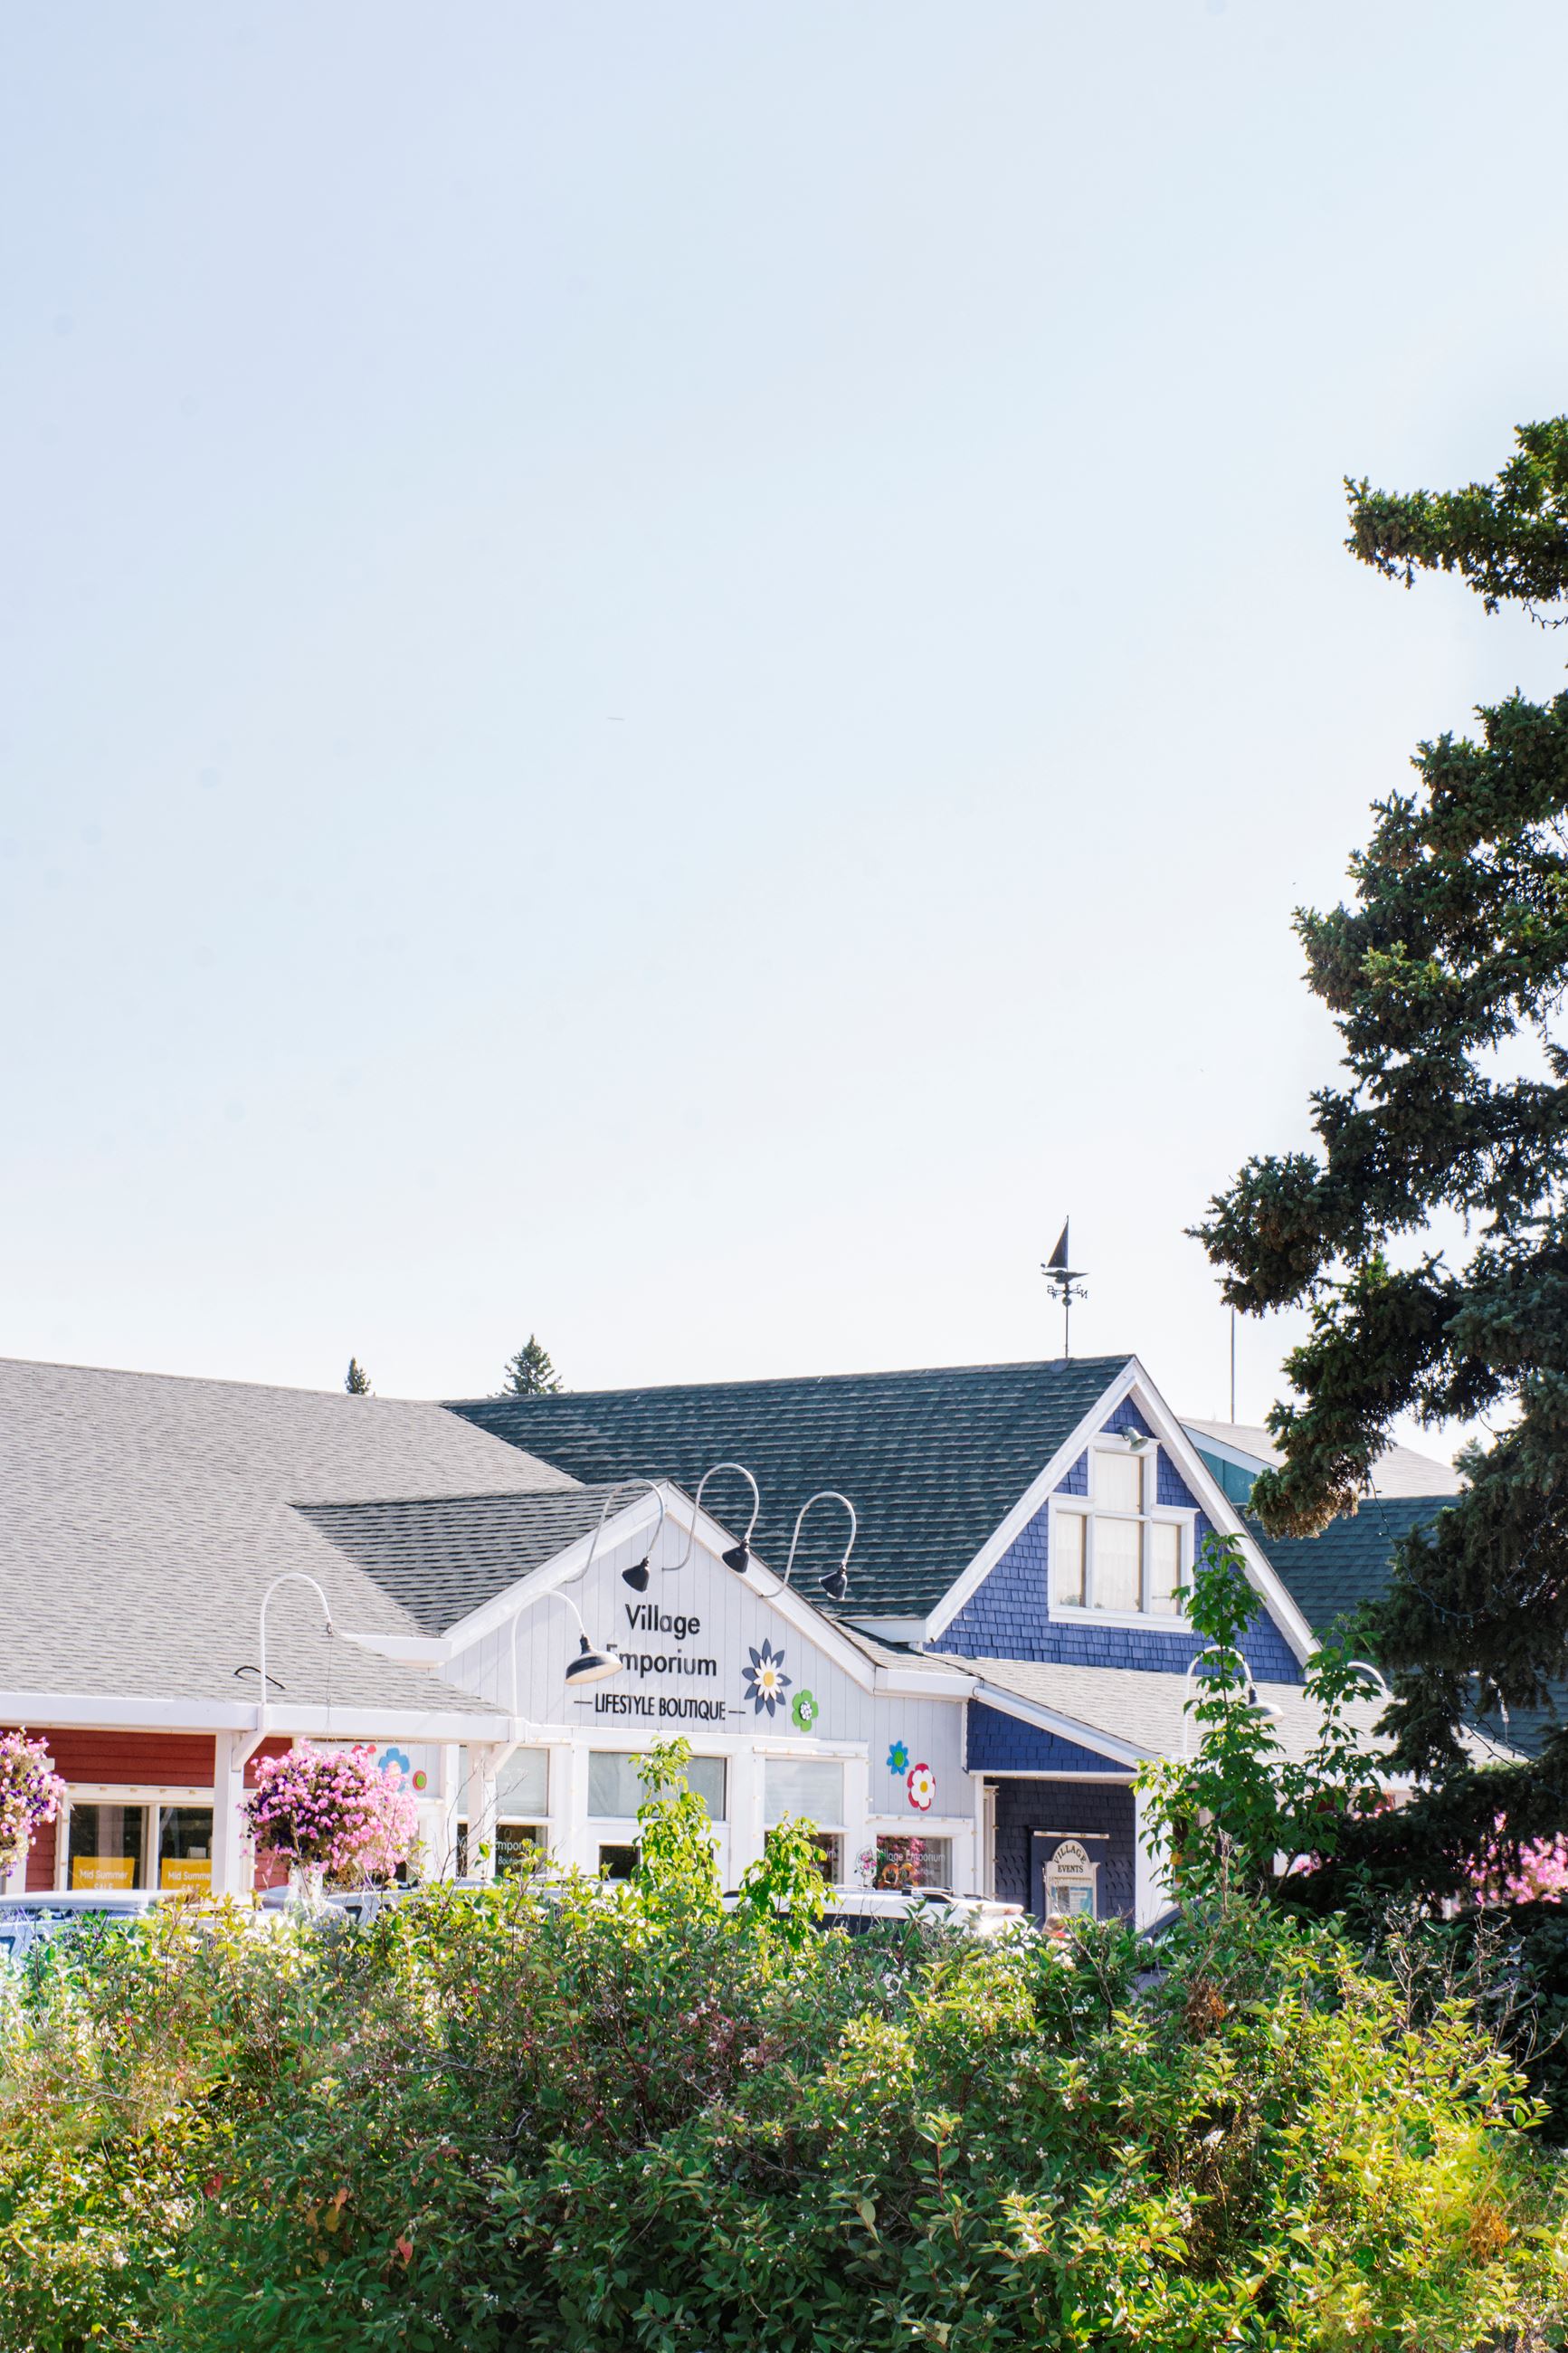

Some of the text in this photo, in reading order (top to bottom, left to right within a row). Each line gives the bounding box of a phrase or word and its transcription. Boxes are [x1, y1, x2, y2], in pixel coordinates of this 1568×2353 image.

[625, 1604, 700, 1640] Village
[594, 1693, 727, 1721] LIFESTYLE BOUTIQUE
[495, 1838, 539, 1853] mpor
[1054, 1844, 1087, 1864] VILLAGE
[79, 1869, 128, 1881] Mid Summer
[167, 1871, 212, 1881] Mid Summe
[1057, 1864, 1084, 1873] EVENTS
